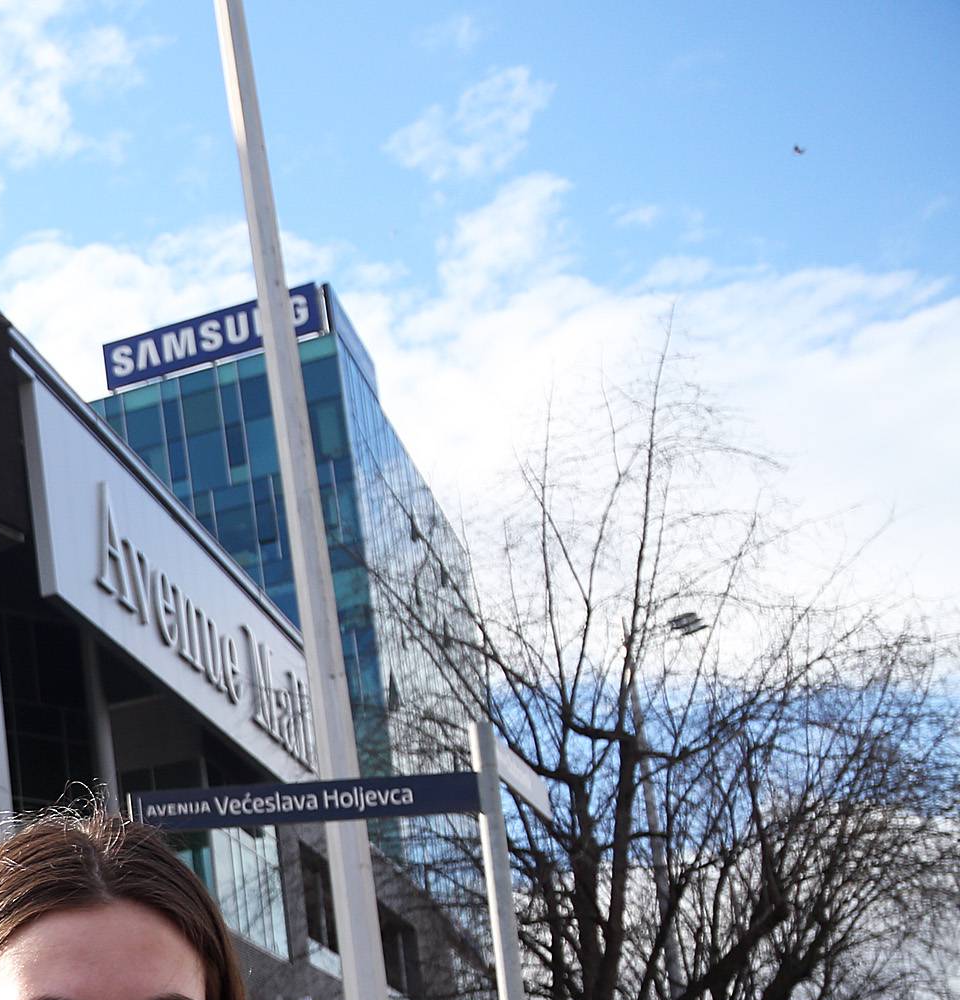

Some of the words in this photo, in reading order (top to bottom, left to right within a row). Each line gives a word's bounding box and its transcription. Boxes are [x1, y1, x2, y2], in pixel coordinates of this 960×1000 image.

[111, 293, 310, 378] SAMSUG
[96, 480, 244, 705] Avenue
[146, 801, 211, 818] AVENIJA
[214, 790, 319, 816] Većeslava
[323, 785, 414, 812] Holjevca
